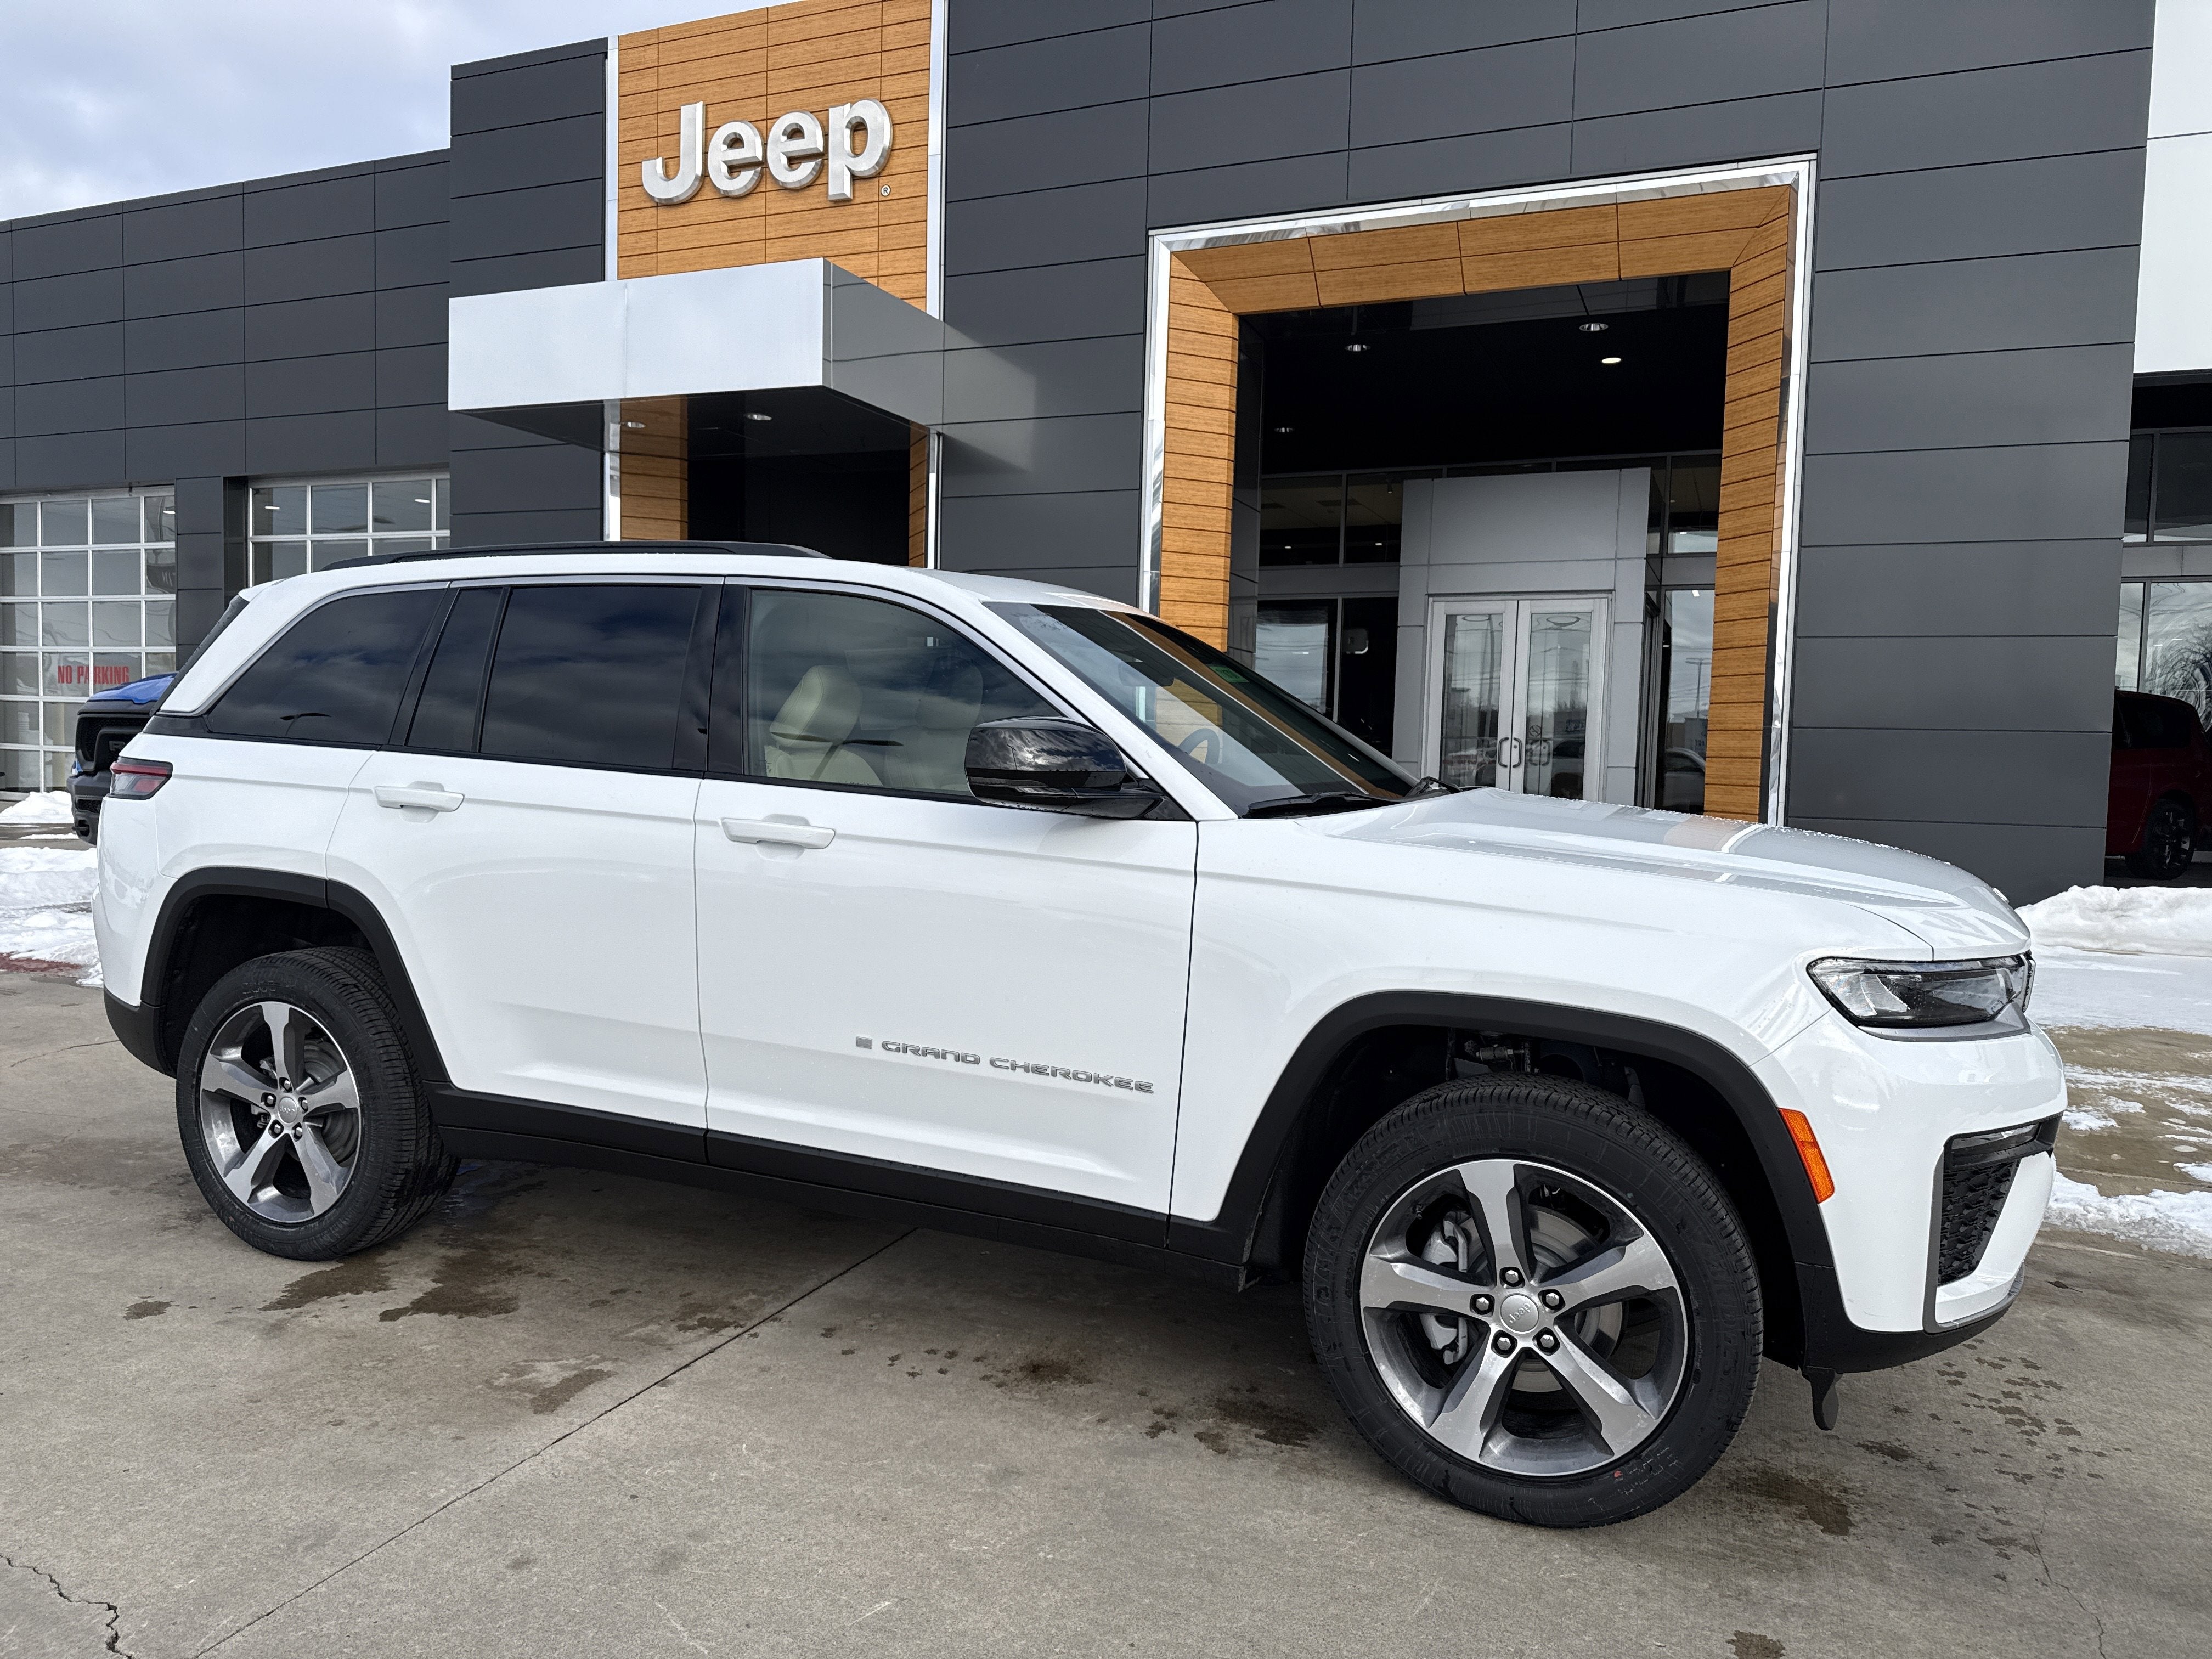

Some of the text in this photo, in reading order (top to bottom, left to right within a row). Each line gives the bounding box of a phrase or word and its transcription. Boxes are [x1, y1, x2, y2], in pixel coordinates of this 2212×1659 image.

[641, 98, 893, 205] Jeep
[57, 665, 130, 685] NO PARKING
[882, 1040, 1154, 1094] GRAND CHEROKEE
[1509, 1303, 1531, 1323] Jeep
